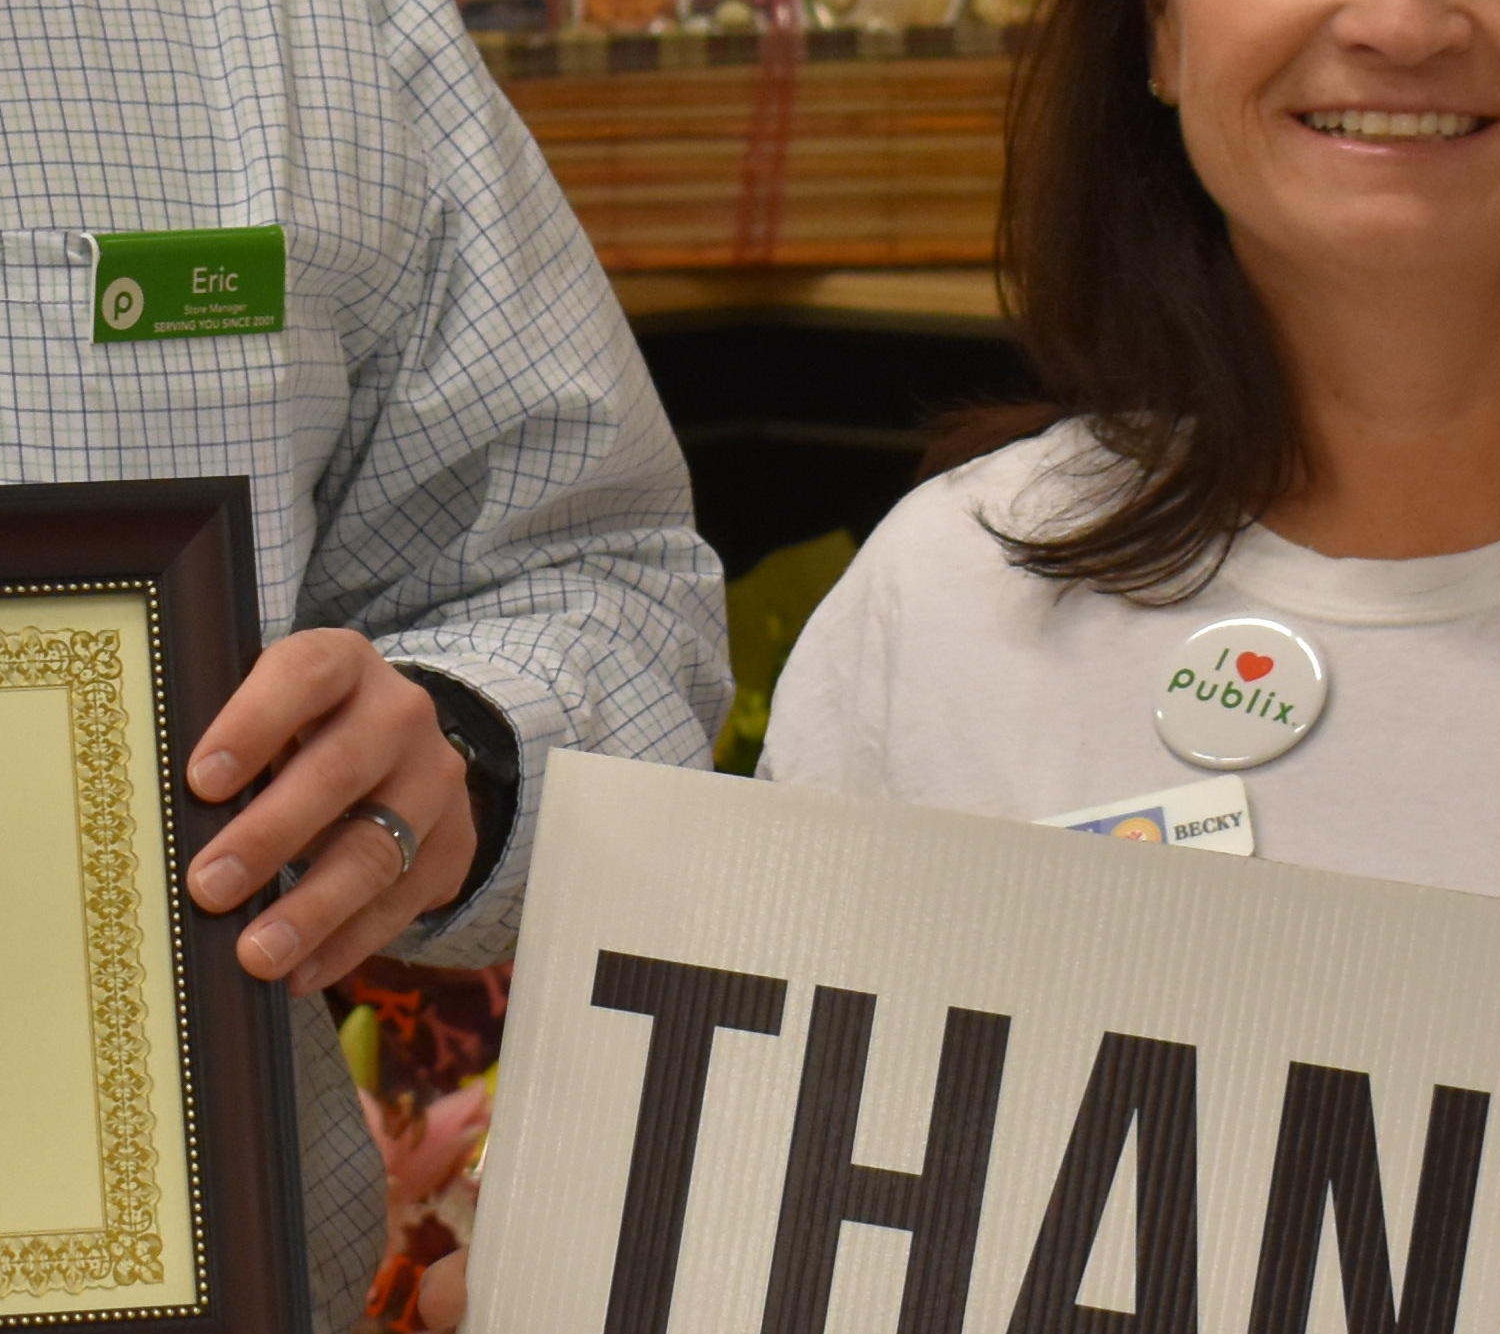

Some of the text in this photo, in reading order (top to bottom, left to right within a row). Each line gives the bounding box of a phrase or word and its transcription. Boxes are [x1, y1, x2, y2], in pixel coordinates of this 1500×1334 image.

[193, 266, 238, 294] Eric
[154, 320, 196, 332] SERVING
[199, 319, 220, 329] YOU
[222, 317, 250, 328] SINCE
[1215, 648, 1231, 671] I
[1174, 811, 1243, 841] BECKY
